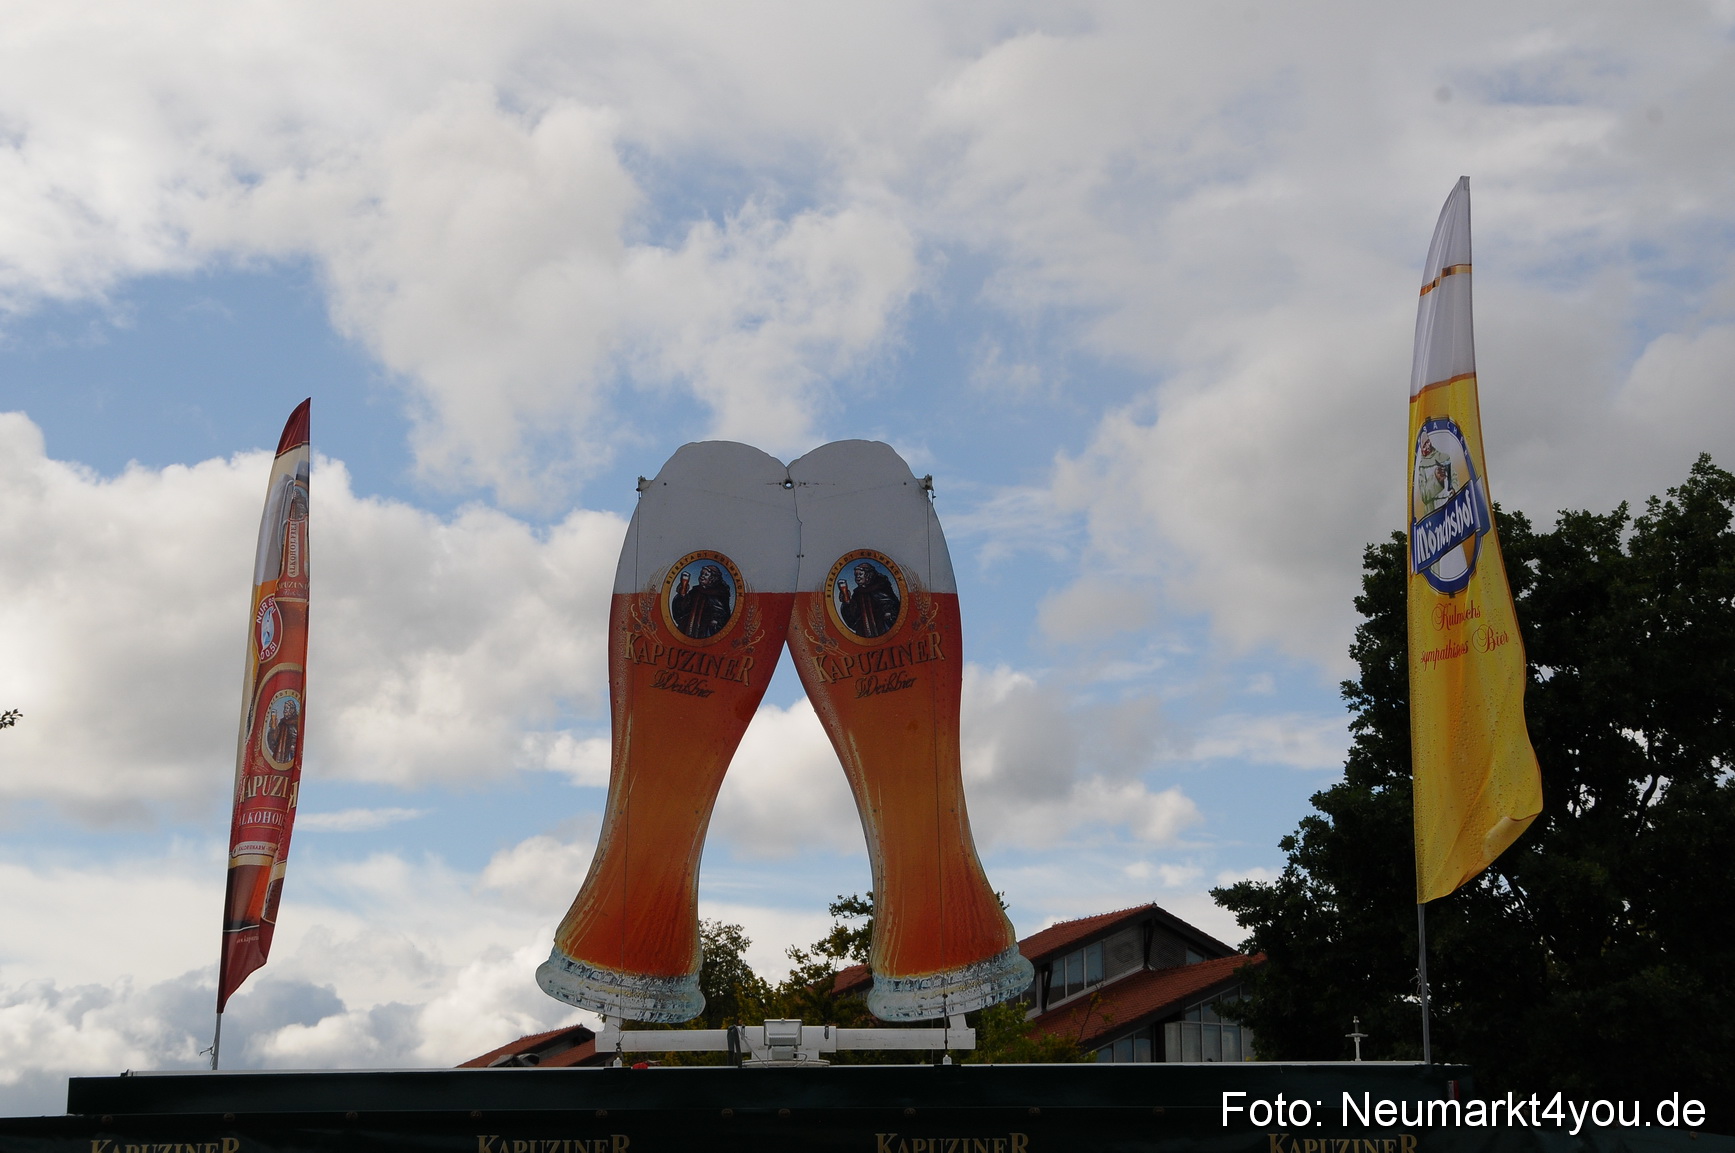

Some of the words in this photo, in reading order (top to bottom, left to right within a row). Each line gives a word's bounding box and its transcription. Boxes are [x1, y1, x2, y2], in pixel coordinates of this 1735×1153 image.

[1417, 488, 1474, 564] Mönchshof
[256, 602, 268, 624] NUR
[1471, 624, 1510, 654] Bier
[624, 631, 755, 687] KAPUZINER
[812, 631, 946, 685] KAPUZINER
